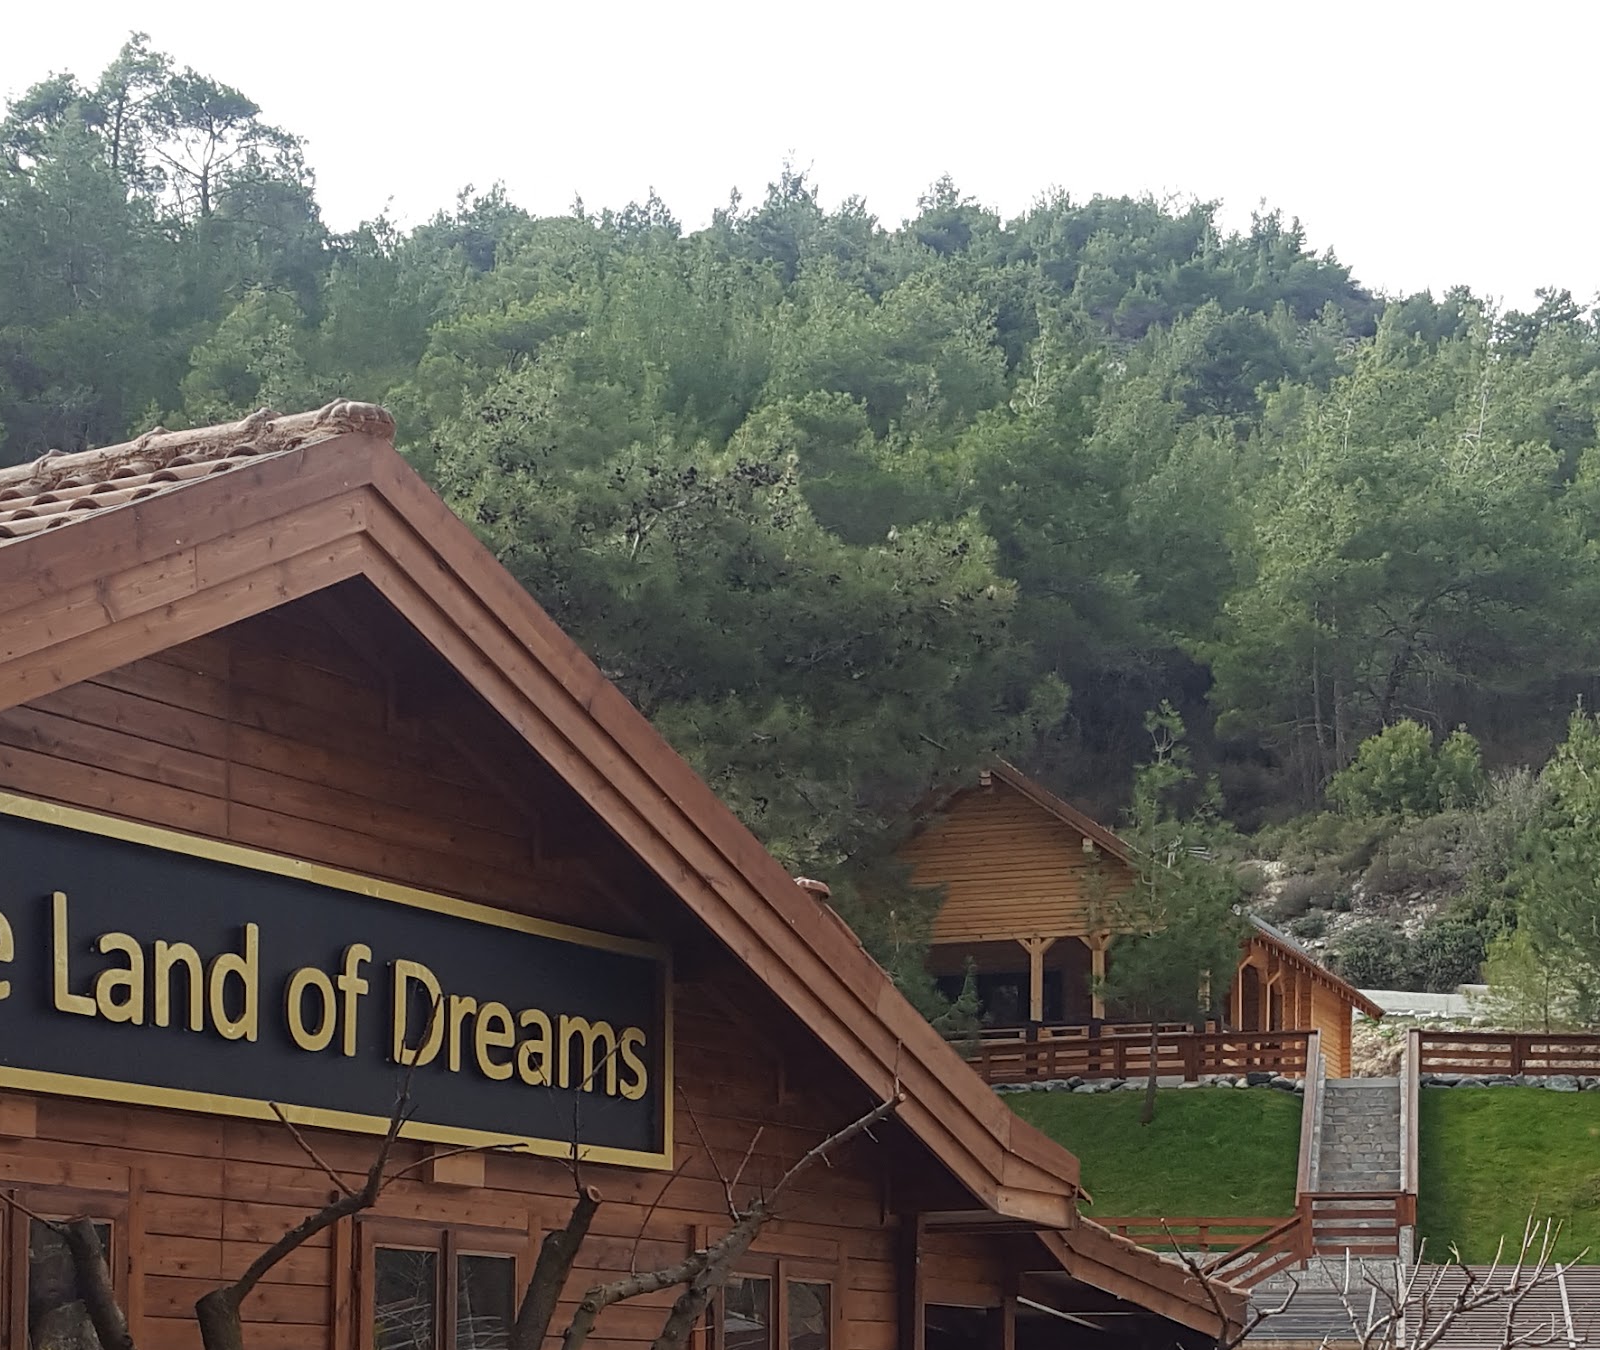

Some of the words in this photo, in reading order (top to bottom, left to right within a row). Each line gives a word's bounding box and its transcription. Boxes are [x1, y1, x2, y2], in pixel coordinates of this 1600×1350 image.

[51, 890, 260, 1043] Land
[286, 942, 373, 1058] of
[390, 957, 649, 1101] Dreams
